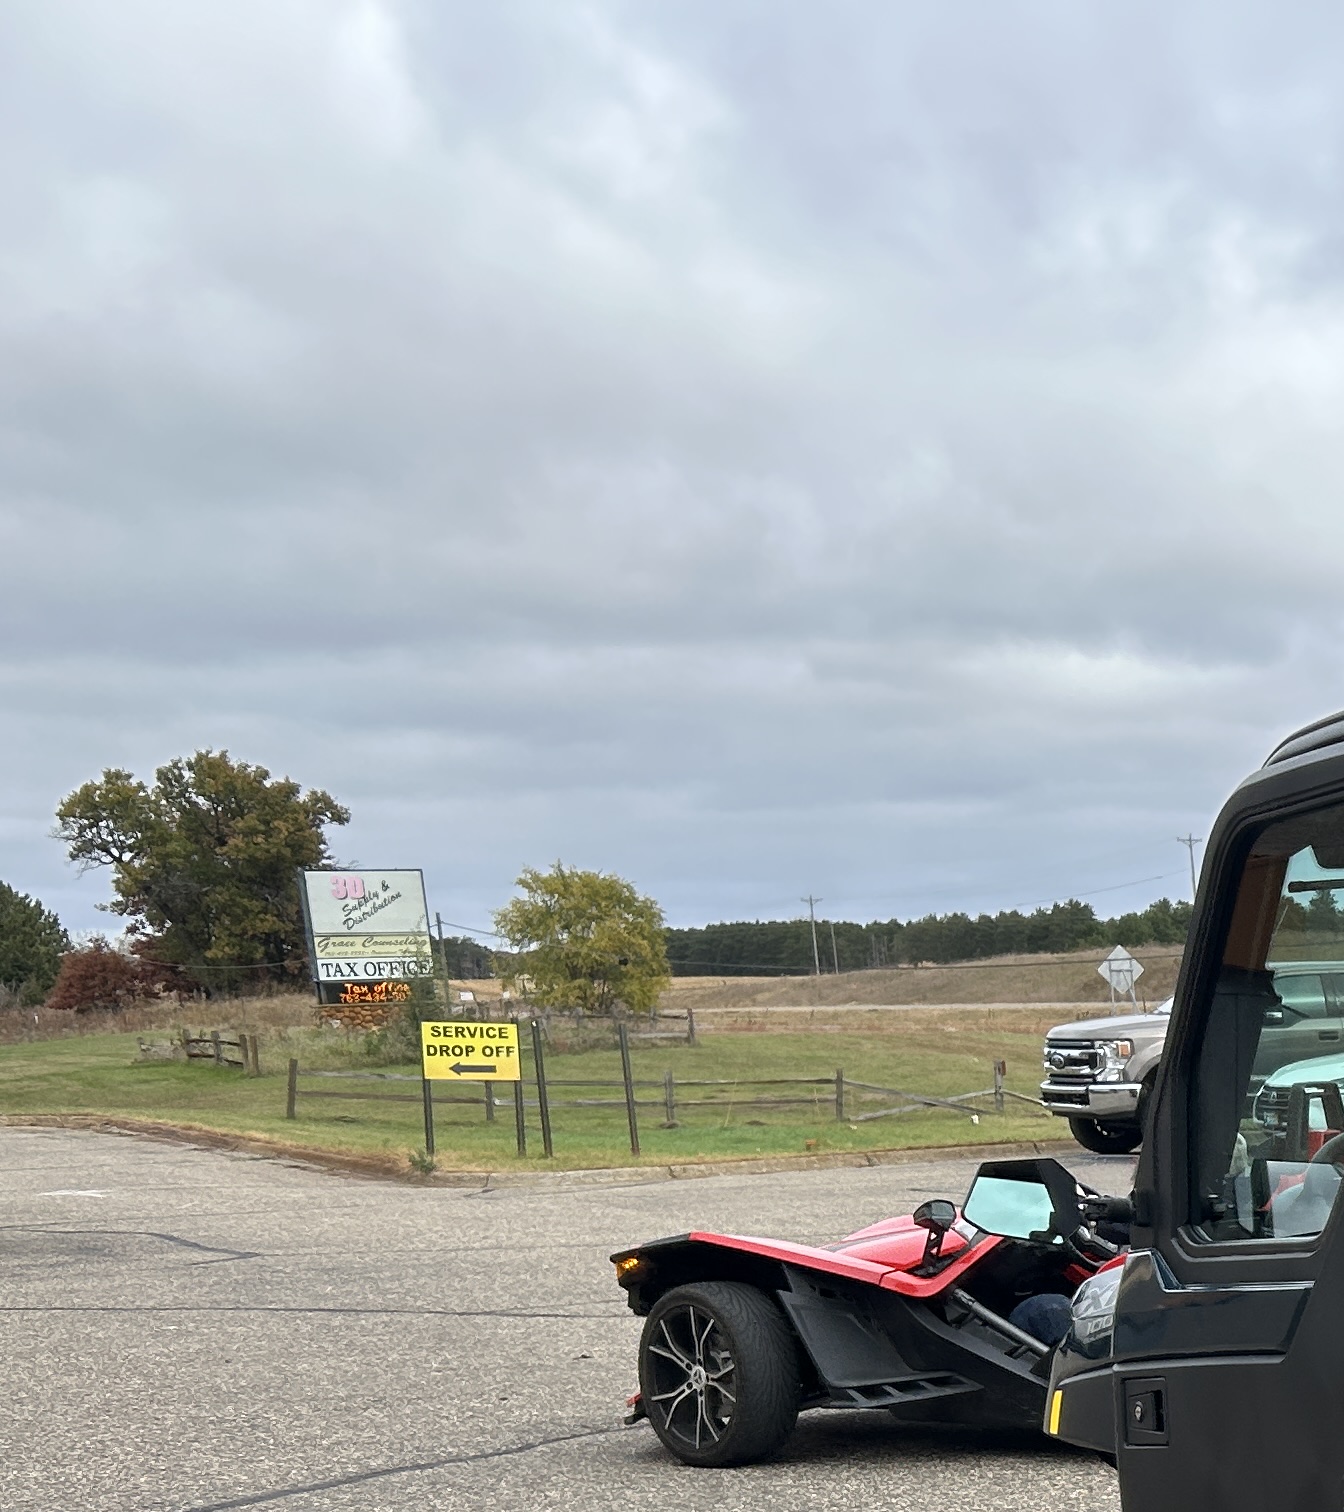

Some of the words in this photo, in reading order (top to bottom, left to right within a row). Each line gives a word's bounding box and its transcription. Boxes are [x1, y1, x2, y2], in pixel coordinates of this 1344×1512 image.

[342, 890, 379, 917] Supply
[381, 880, 391, 892] &
[342, 891, 402, 930] Distribution
[318, 936, 357, 953] Grace
[321, 962, 359, 978] TAX
[364, 960, 431, 977] OFFICE
[344, 983, 369, 994] Tax
[430, 1025, 509, 1039] SERVICE
[426, 1044, 475, 1057] DROP
[481, 1045, 515, 1057] OFF
